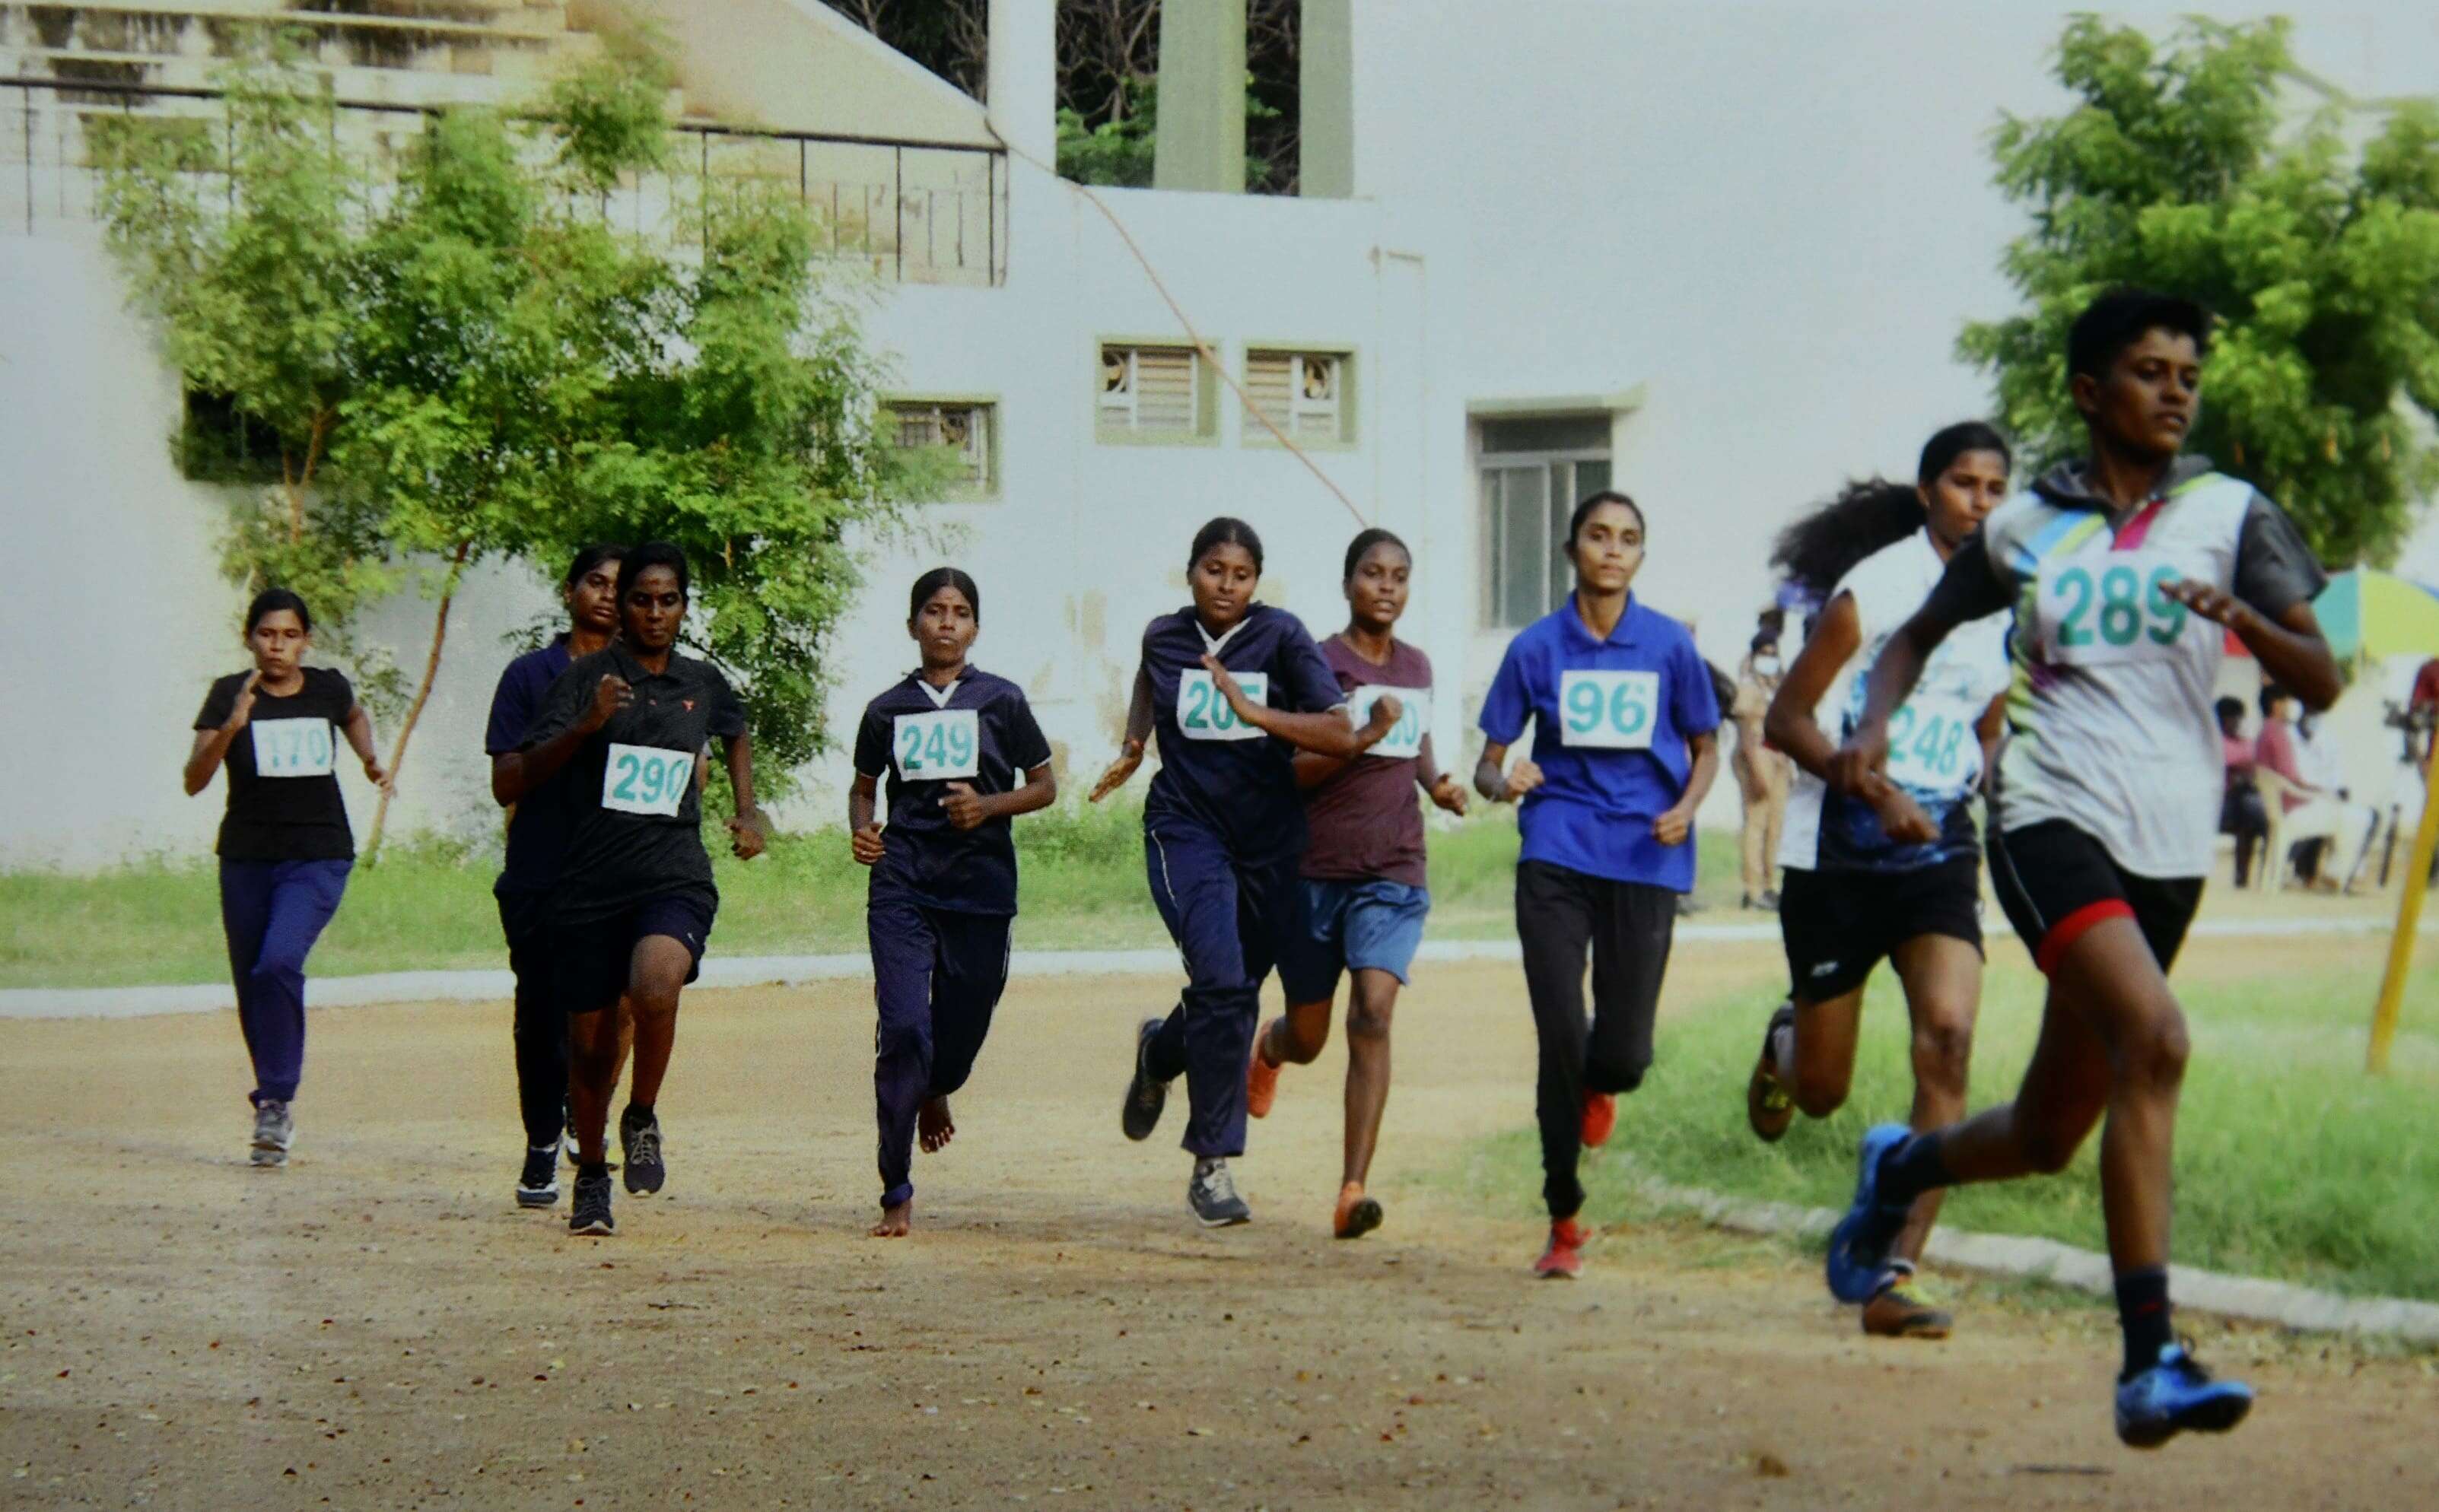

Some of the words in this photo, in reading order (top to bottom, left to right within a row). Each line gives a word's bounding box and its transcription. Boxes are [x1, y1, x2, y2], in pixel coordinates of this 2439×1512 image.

[2056, 566, 2188, 646] 289
[1568, 680, 1646, 735] 96
[902, 721, 972, 769] 249
[1889, 705, 1964, 776] 248
[613, 754, 688, 803] 290
